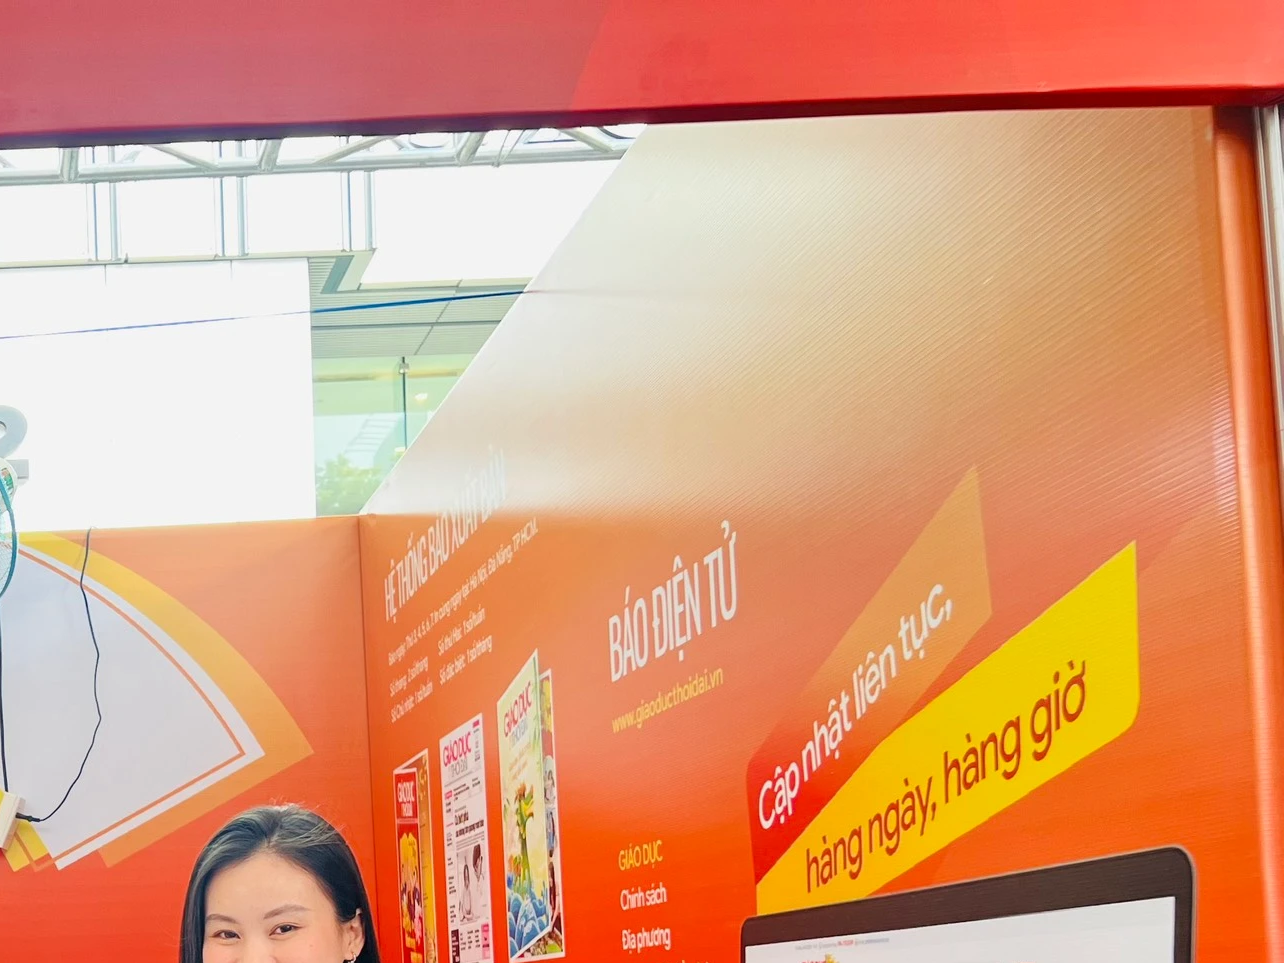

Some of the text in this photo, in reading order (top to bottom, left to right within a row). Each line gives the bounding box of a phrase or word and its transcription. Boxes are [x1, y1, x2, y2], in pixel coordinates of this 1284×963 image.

[384, 559, 398, 624] HỆ
[396, 532, 427, 608] THỐNG
[609, 520, 737, 682] BÁO ĐIỆN TỬ
[612, 668, 723, 733] www.giaoducthoidai.vn
[759, 584, 952, 829] Cập nhật liên tục,
[806, 660, 1086, 893] hàng ngày, hàng giờ
[619, 840, 663, 870] GIÁO DỤC
[620, 882, 667, 911] Chính sách
[622, 927, 671, 954] Địa phương
